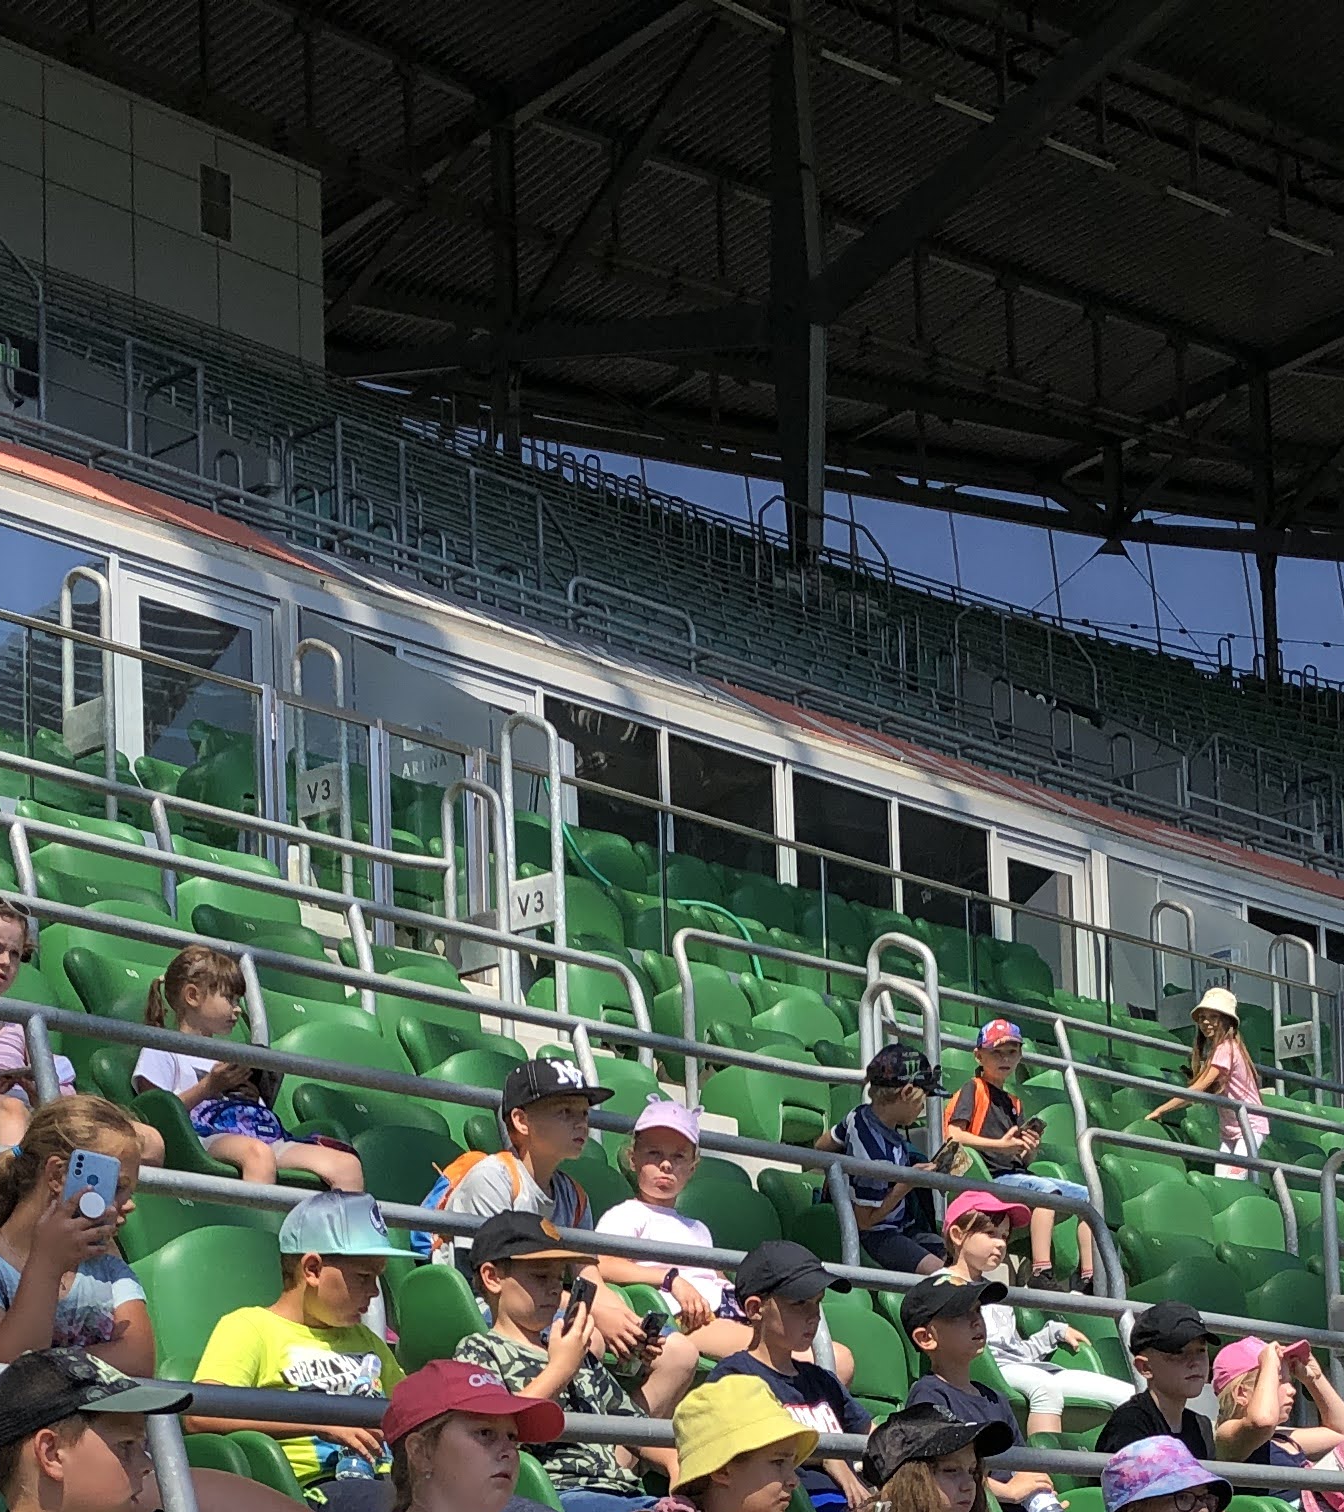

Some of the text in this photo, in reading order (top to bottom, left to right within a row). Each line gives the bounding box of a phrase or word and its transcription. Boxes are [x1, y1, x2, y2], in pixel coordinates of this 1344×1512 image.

[307, 779, 331, 804] V3
[517, 890, 544, 917] V3
[1284, 1034, 1306, 1050] V3
